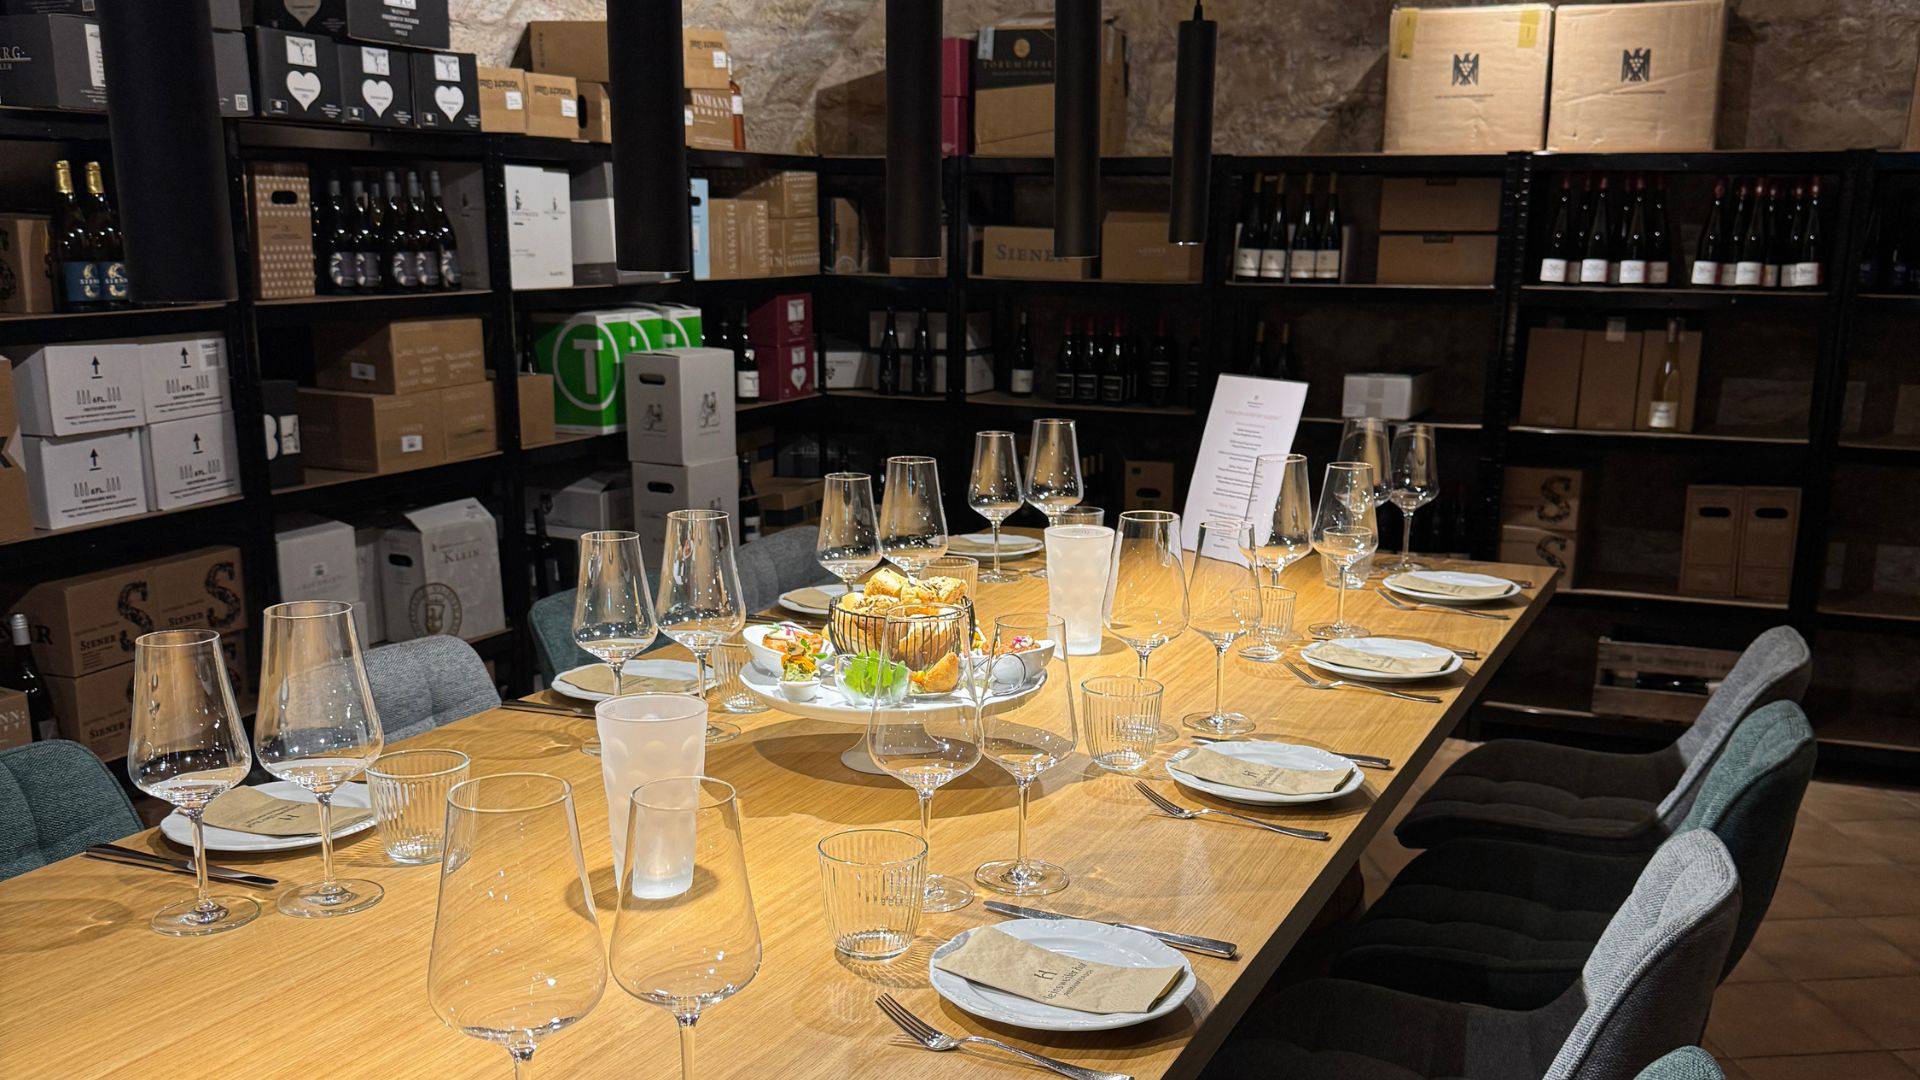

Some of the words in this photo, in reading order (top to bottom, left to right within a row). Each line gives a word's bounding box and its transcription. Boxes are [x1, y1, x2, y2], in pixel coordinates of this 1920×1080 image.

[573, 339, 604, 395] T
[444, 549, 480, 564] KLEIN
[168, 611, 204, 626] SIENER
[80, 634, 117, 652] SIENER
[88, 720, 125, 740] SIENER
